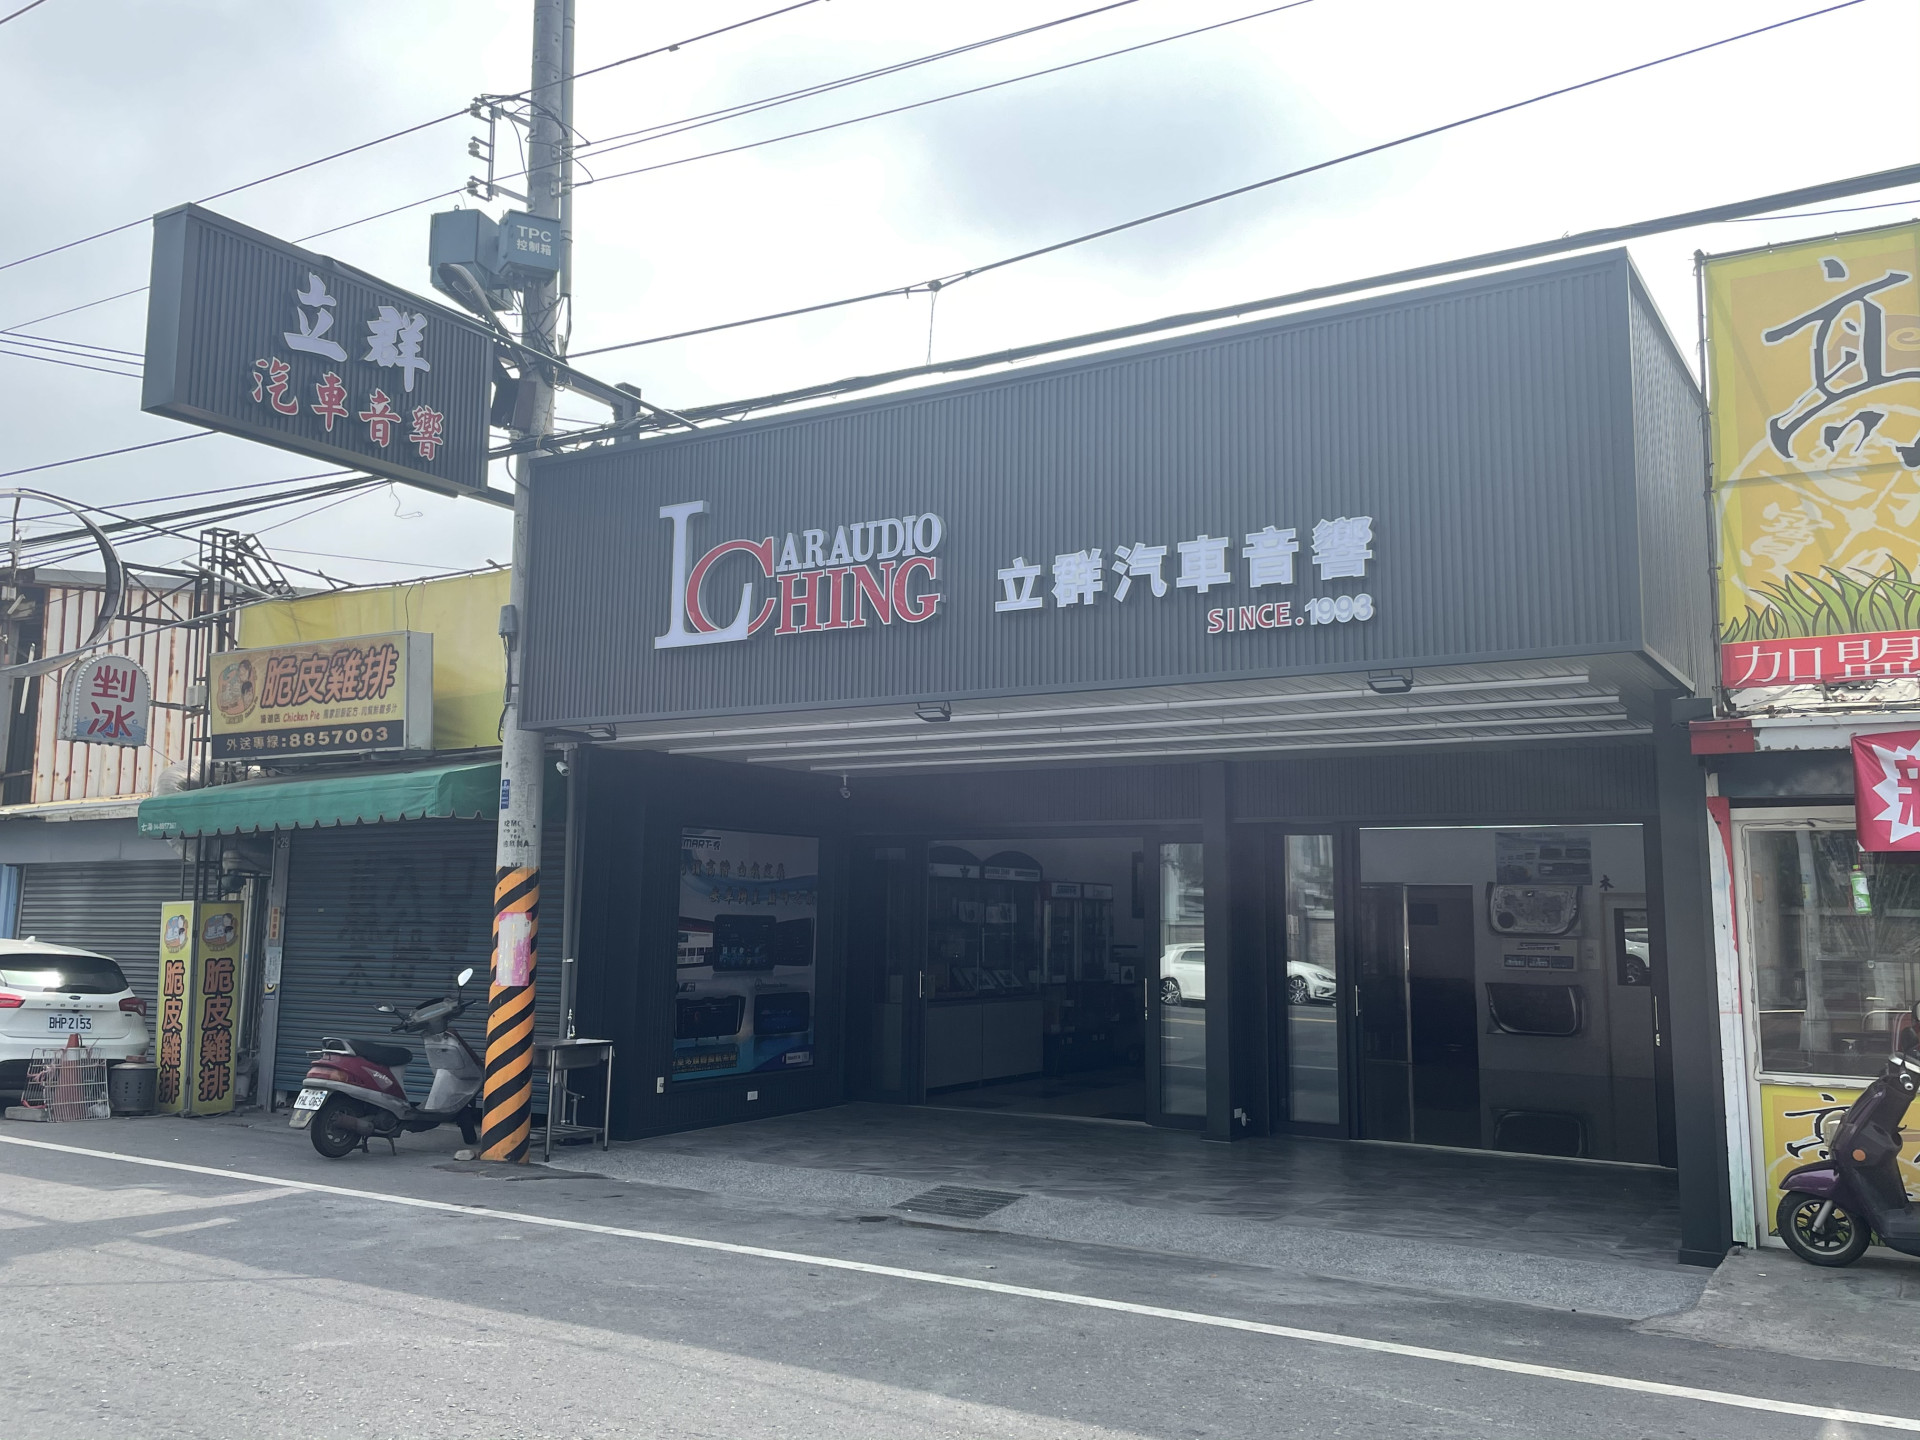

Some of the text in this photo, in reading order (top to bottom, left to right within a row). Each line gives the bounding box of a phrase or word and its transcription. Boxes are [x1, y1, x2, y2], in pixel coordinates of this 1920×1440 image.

[516, 225, 552, 243] TPC
[516, 238, 552, 256] 控制箱
[283, 272, 430, 392] 立群
[251, 357, 444, 461] 汽車音響
[995, 515, 1374, 612] 立群汽車音響
[258, 643, 400, 709] 脆皮雞排
[1735, 636, 1920, 686] 加盟
[87, 665, 137, 738] 剉冰
[283, 710, 320, 723] Chicken Pie
[159, 959, 185, 1104] 脆皮雞排
[198, 957, 235, 1102] 脆皮雞排
